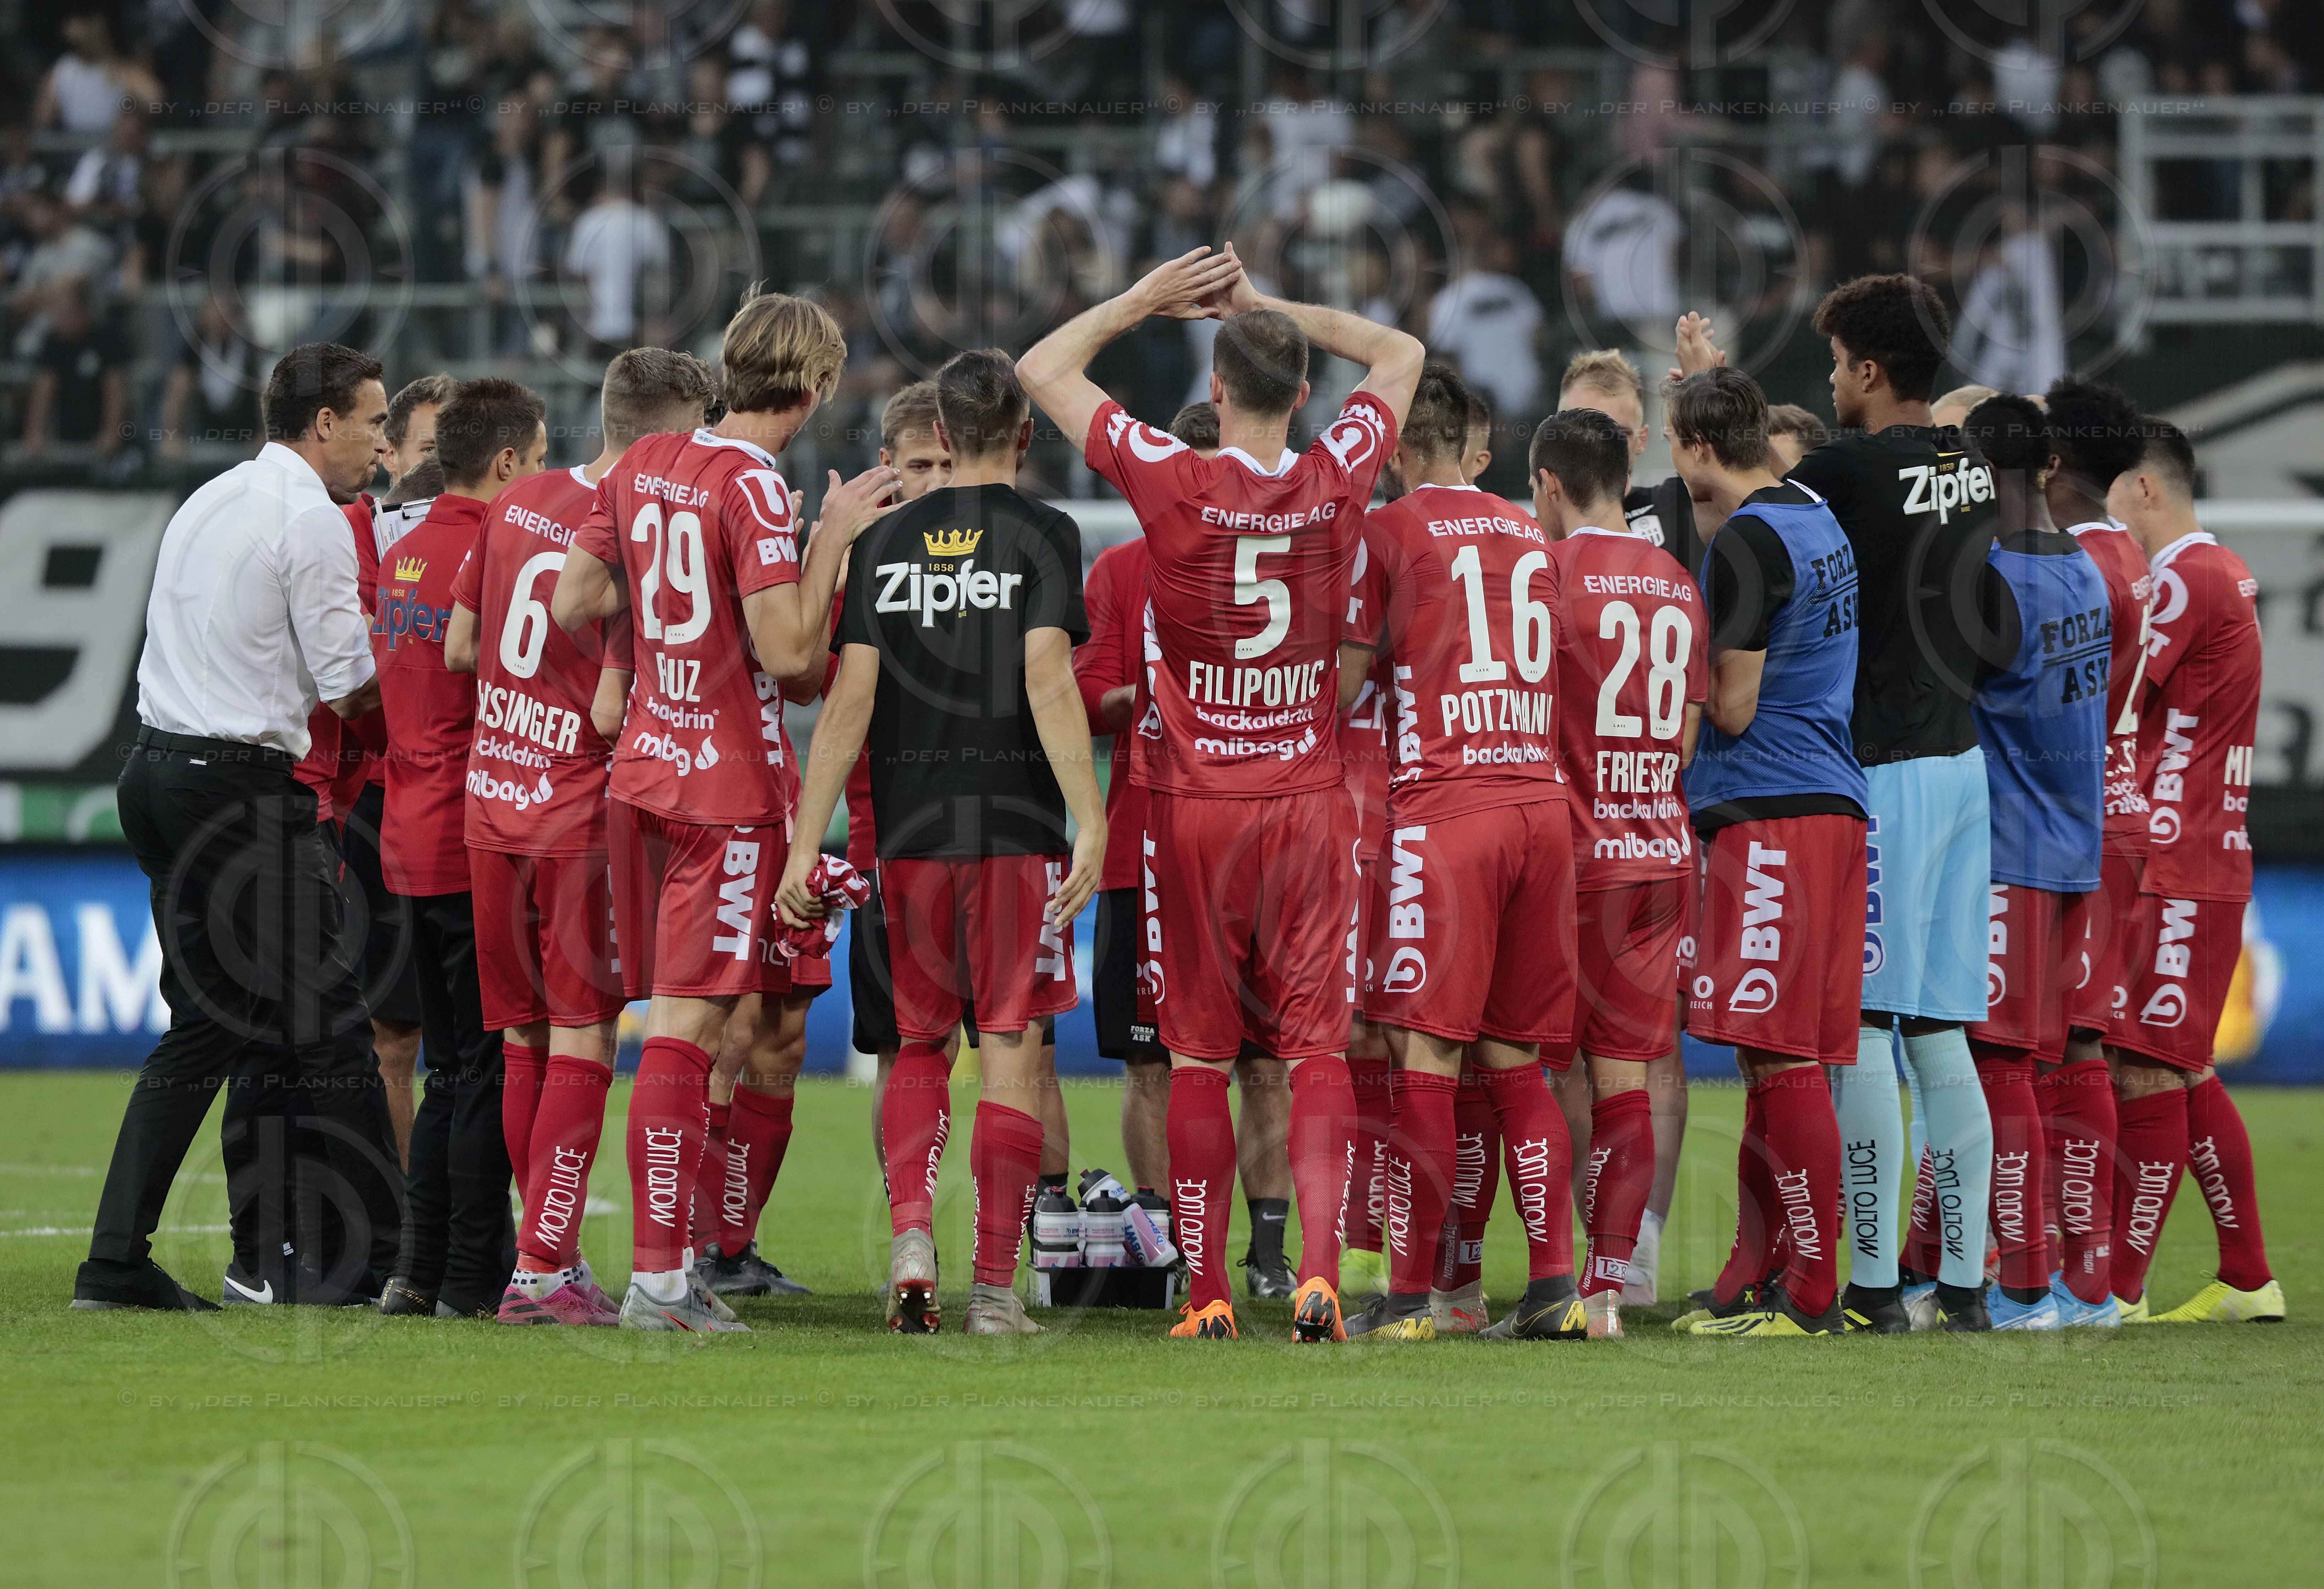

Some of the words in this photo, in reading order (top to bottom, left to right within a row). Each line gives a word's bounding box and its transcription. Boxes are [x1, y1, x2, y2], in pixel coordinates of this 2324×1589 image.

[392, 589, 405, 597] 1858
[631, 503, 711, 645] 29
[875, 559, 1023, 628] Zipfer
[928, 563, 954, 572] 1858
[499, 552, 569, 679] 6
[1235, 535, 1291, 659] 5
[1451, 545, 1550, 683] 16
[1189, 659, 1324, 707] FILIPOVIC
[1596, 601, 1692, 740] 28
[2153, 708, 2199, 802] BWT
[713, 841, 760, 961] BWT
[1740, 841, 1786, 961] BWT
[1130, 1025, 1155, 1034] FORZA
[1133, 1034, 1151, 1043] ASK
[550, 1146, 587, 1189] LUCE
[645, 1127, 682, 1164] LUCE
[727, 1138, 750, 1172] LUCE
[1513, 1138, 1549, 1181] LUCE
[1847, 1139, 1877, 1184] LUCE
[1931, 1149, 1962, 1189] LUCE
[1996, 1151, 2029, 1186] LUCE
[2063, 1139, 2099, 1177] LUCE
[647, 1168, 678, 1228] MOLTO
[723, 1172, 748, 1227] MOLTO
[1176, 1178, 1207, 1216] LUCE
[1388, 1153, 1411, 1196] LUCE
[1775, 1169, 1810, 1206] LUCE
[2139, 1162, 2174, 1194] LUCE
[536, 1188, 576, 1250] MOLTO
[1389, 1198, 1410, 1256] MOLTO
[1521, 1184, 1547, 1242] MOLTO
[1787, 1206, 1822, 1260] MOLTO
[1854, 1191, 1878, 1258] MOLTO
[1941, 1195, 1963, 1260] MOLTO
[1996, 1190, 2026, 1242] MOLTO
[2062, 1180, 2094, 1235] MOLTO
[2126, 1196, 2163, 1256] MOLTO
[1179, 1218, 1204, 1276] MOLTO
